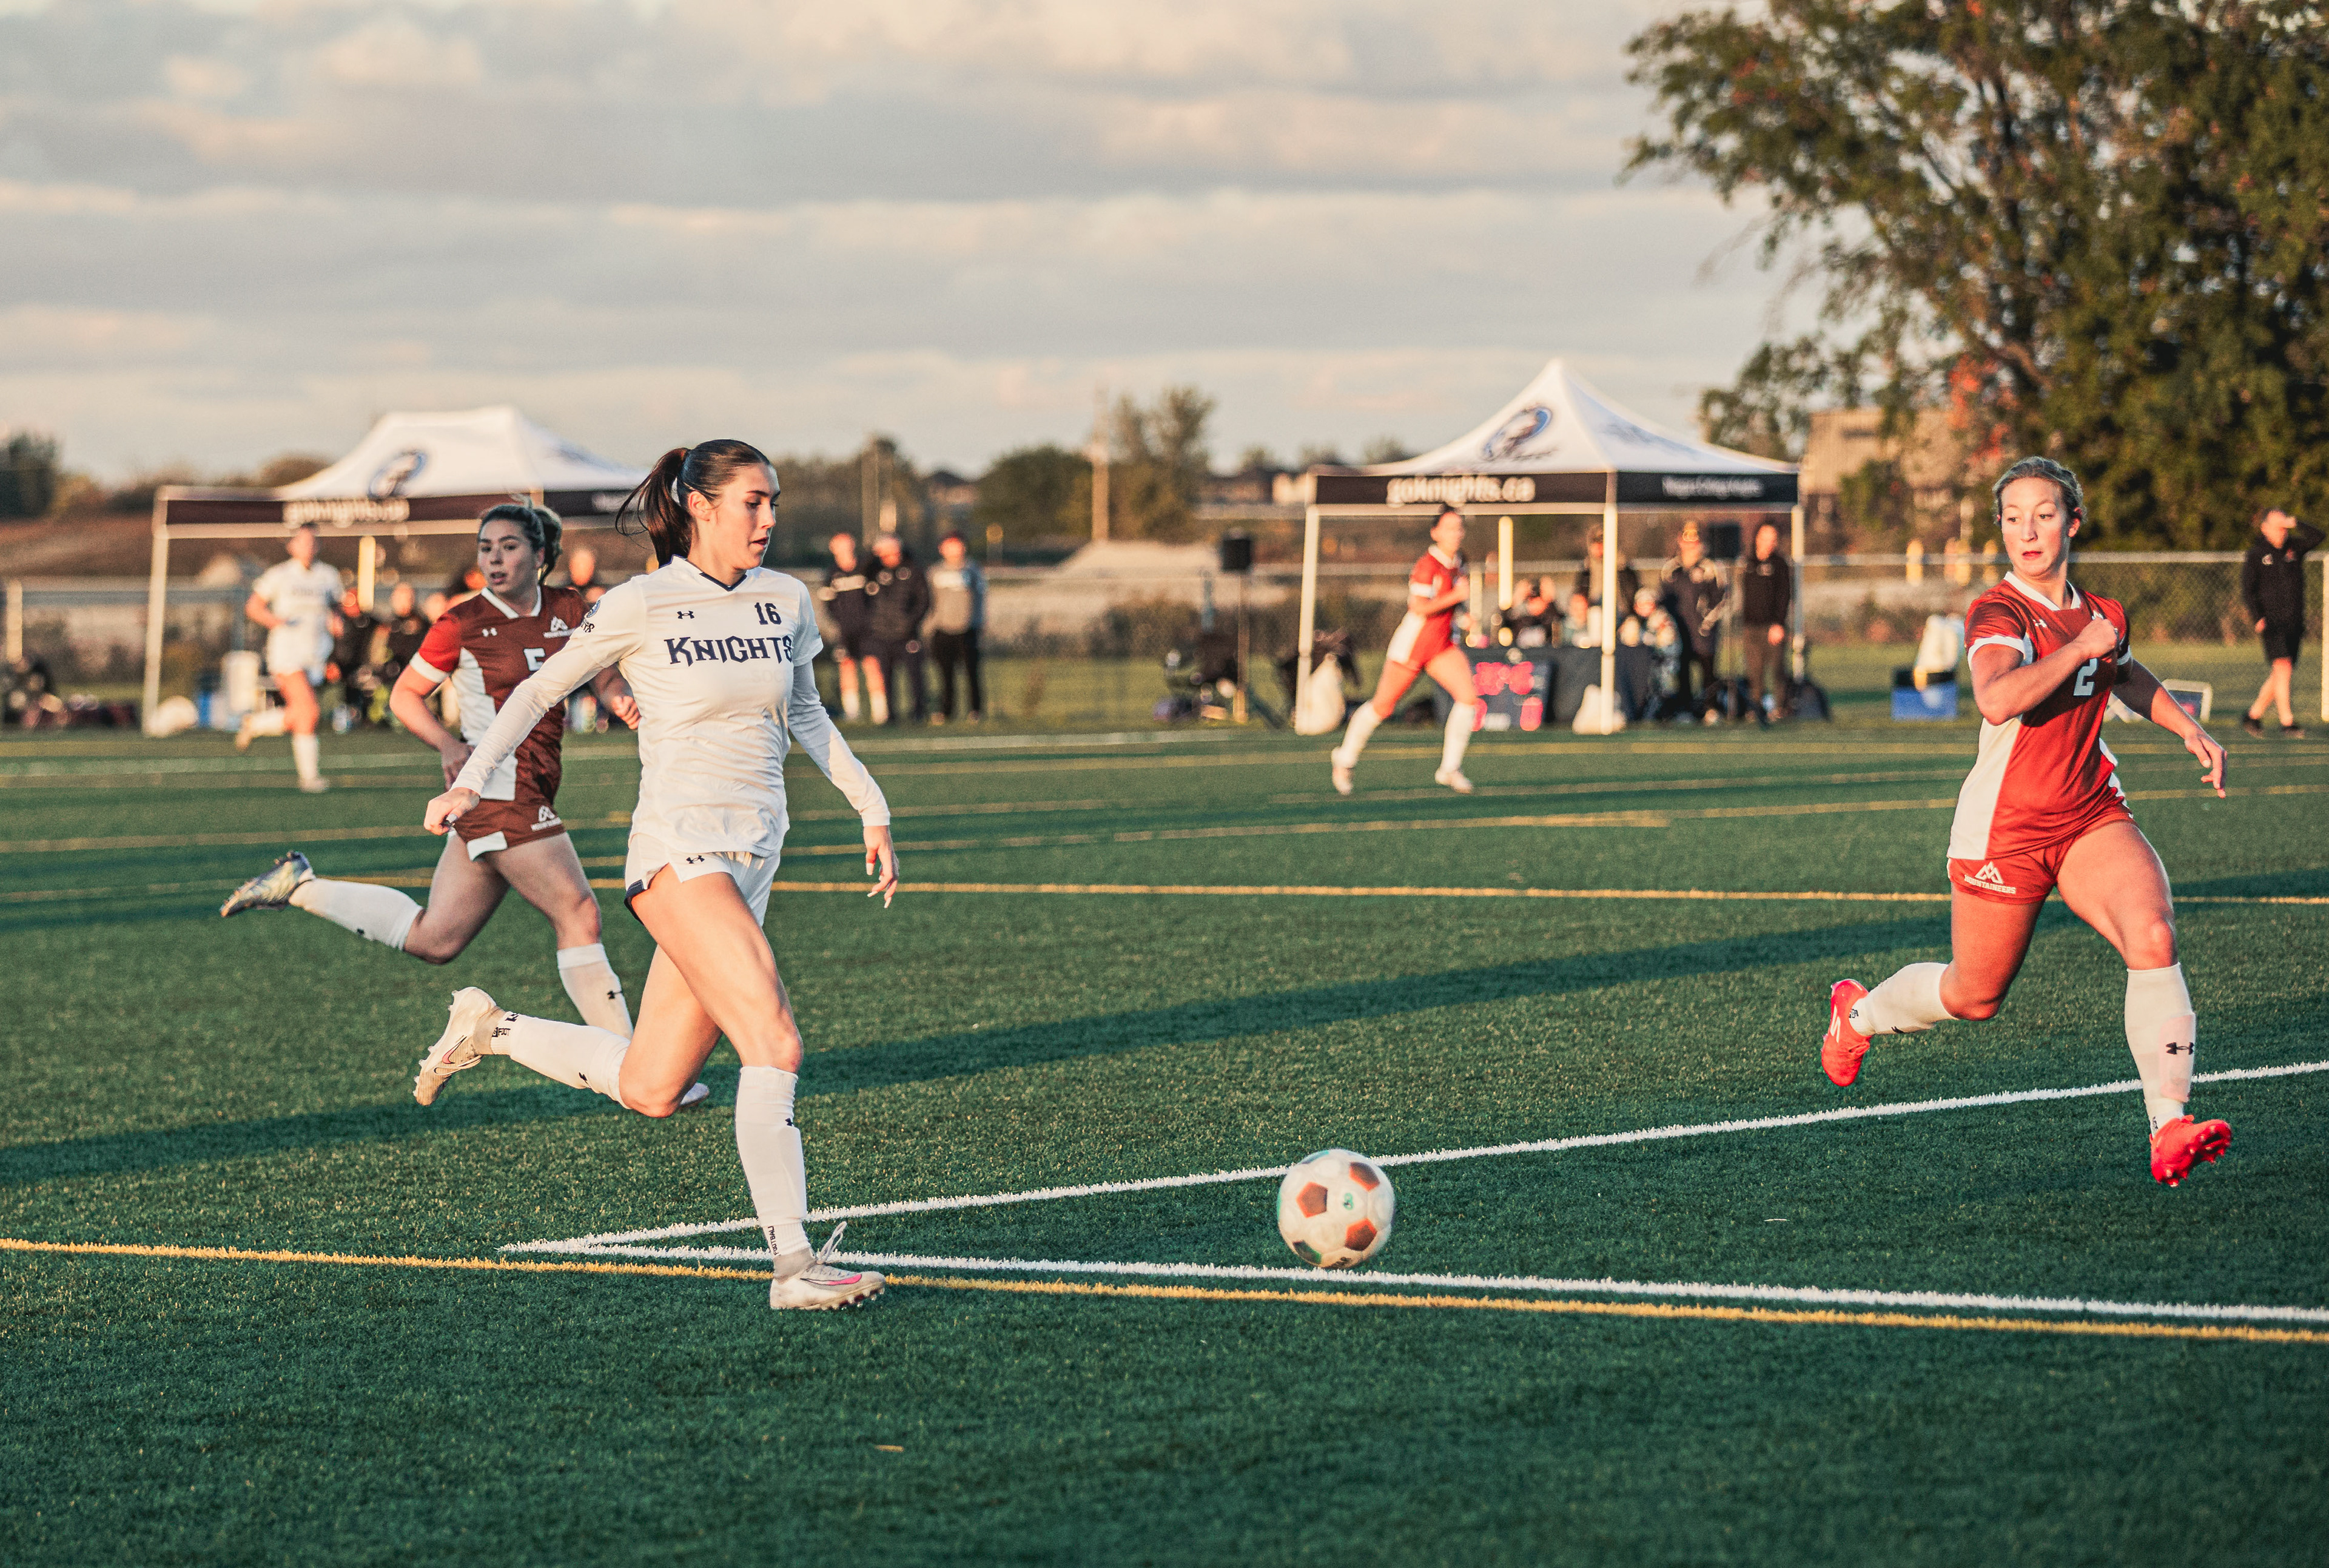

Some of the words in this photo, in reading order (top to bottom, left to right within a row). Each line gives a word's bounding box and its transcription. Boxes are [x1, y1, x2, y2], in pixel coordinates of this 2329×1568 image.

[754, 602, 782, 625] 16
[523, 648, 545, 671] 5
[664, 636, 793, 667] KNIGHTS
[2073, 658, 2097, 696] 2
[1964, 874, 2017, 894] MOUNTAINEERS
